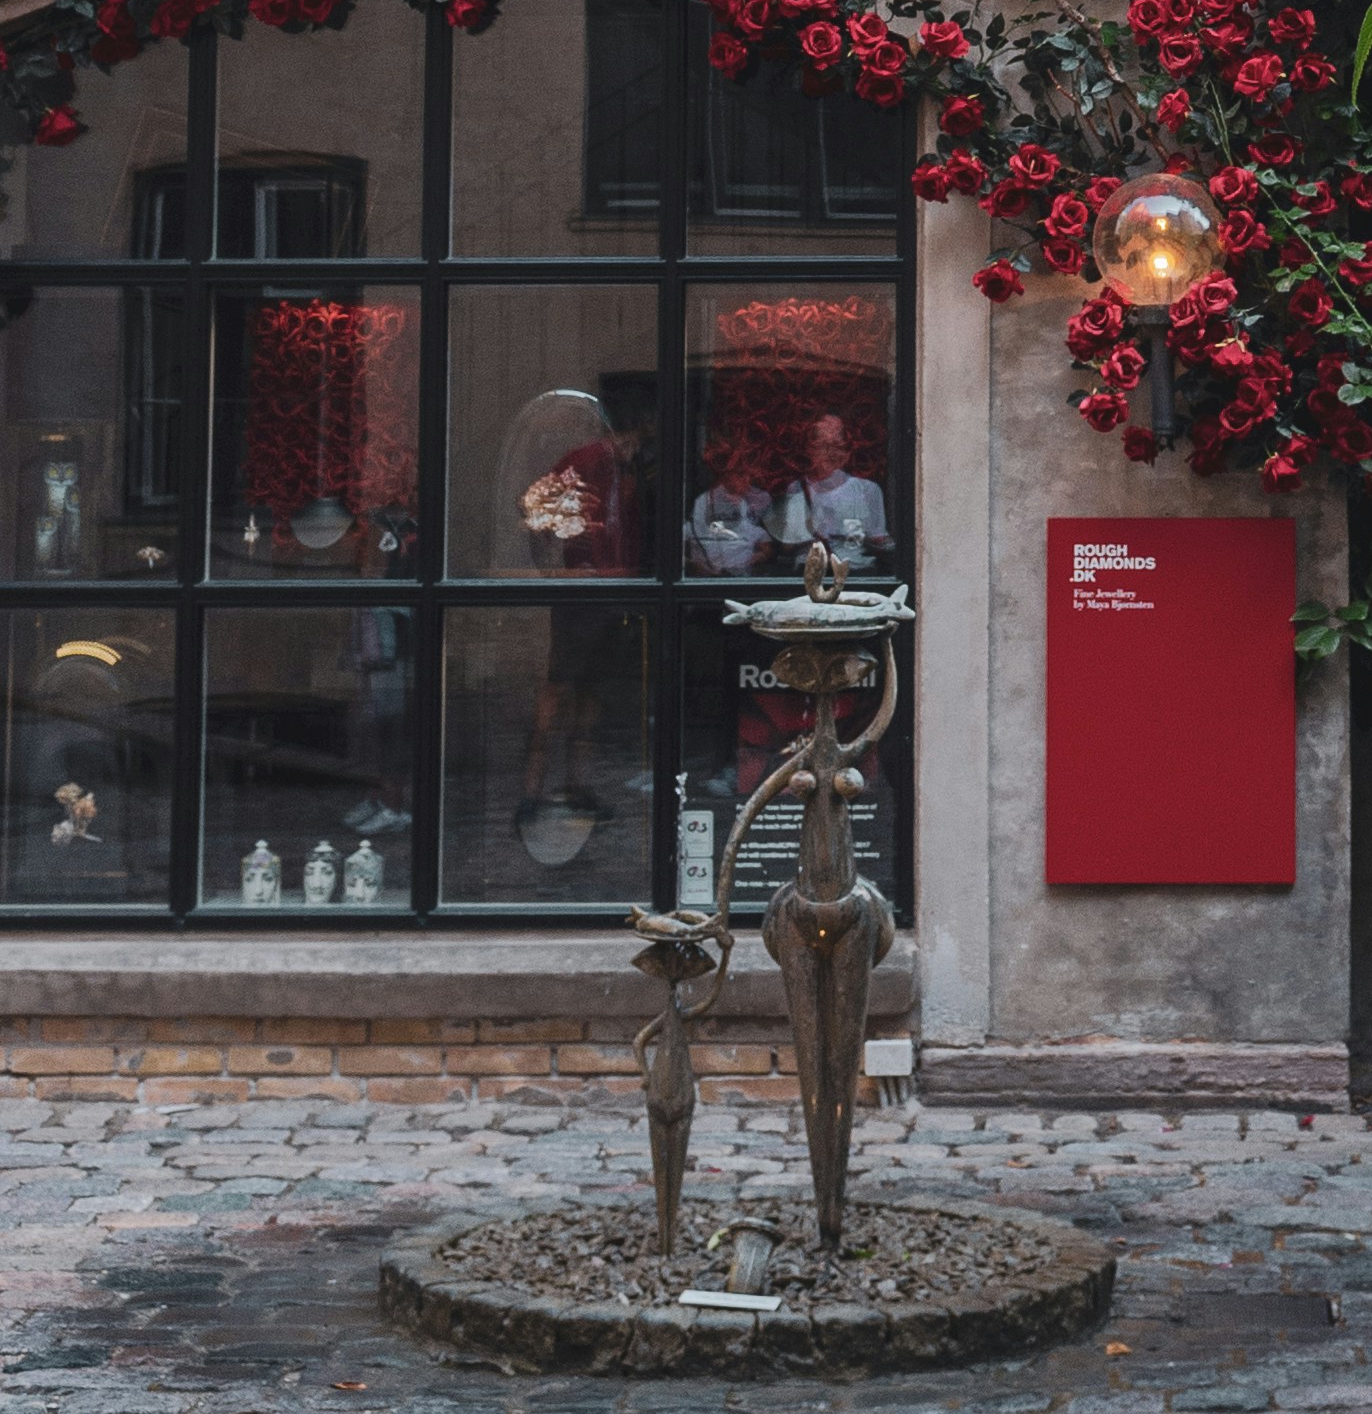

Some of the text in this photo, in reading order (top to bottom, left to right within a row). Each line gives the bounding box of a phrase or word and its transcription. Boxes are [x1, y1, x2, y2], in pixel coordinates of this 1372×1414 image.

[1073, 543, 1128, 557] ROUGH
[1073, 557, 1156, 570] DIAMONDS
[1069, 569, 1097, 583] .DK
[1073, 588, 1137, 601] Fine Jewellery
[1073, 599, 1085, 611] by
[1086, 599, 1110, 611] Maya
